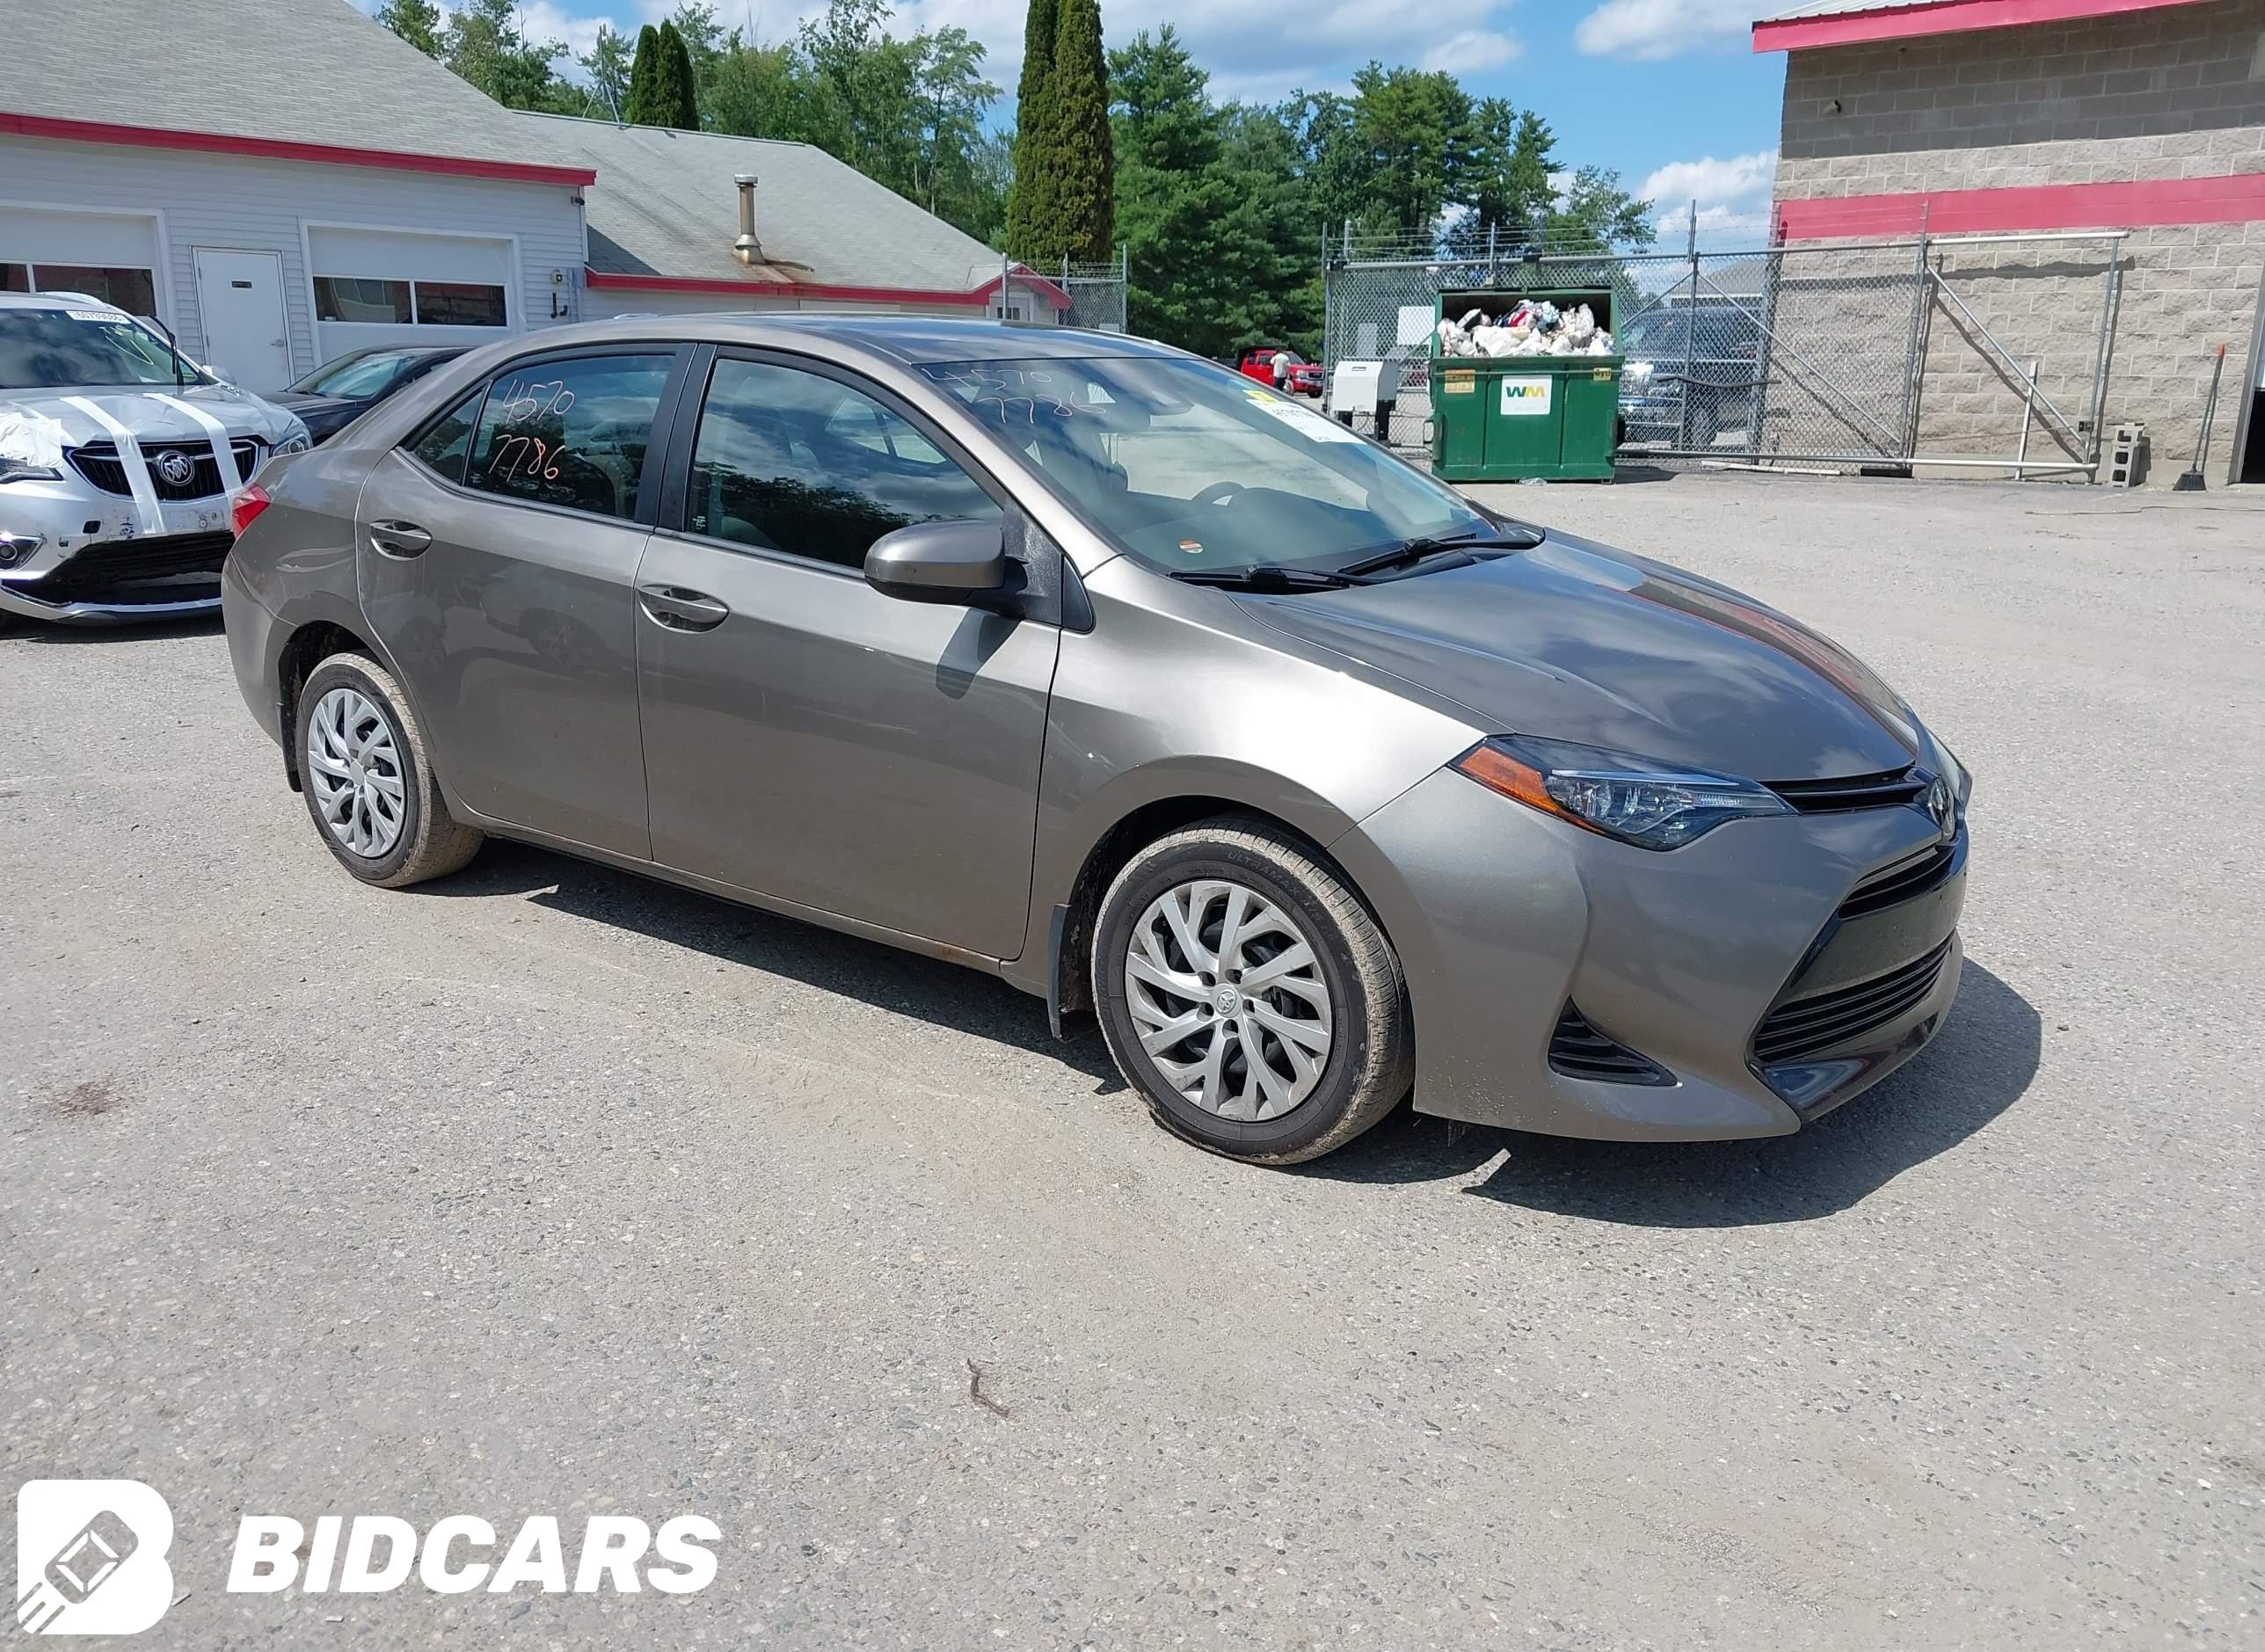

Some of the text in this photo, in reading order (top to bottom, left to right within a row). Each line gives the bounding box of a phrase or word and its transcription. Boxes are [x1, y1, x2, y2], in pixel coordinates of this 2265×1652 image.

[921, 368, 1052, 390] 4570
[1506, 387, 1546, 397] WM
[503, 379, 575, 423] 4570
[977, 391, 1106, 424] 7786
[488, 434, 565, 482] 7786
[1227, 850, 1301, 896] ULTRAMAX
